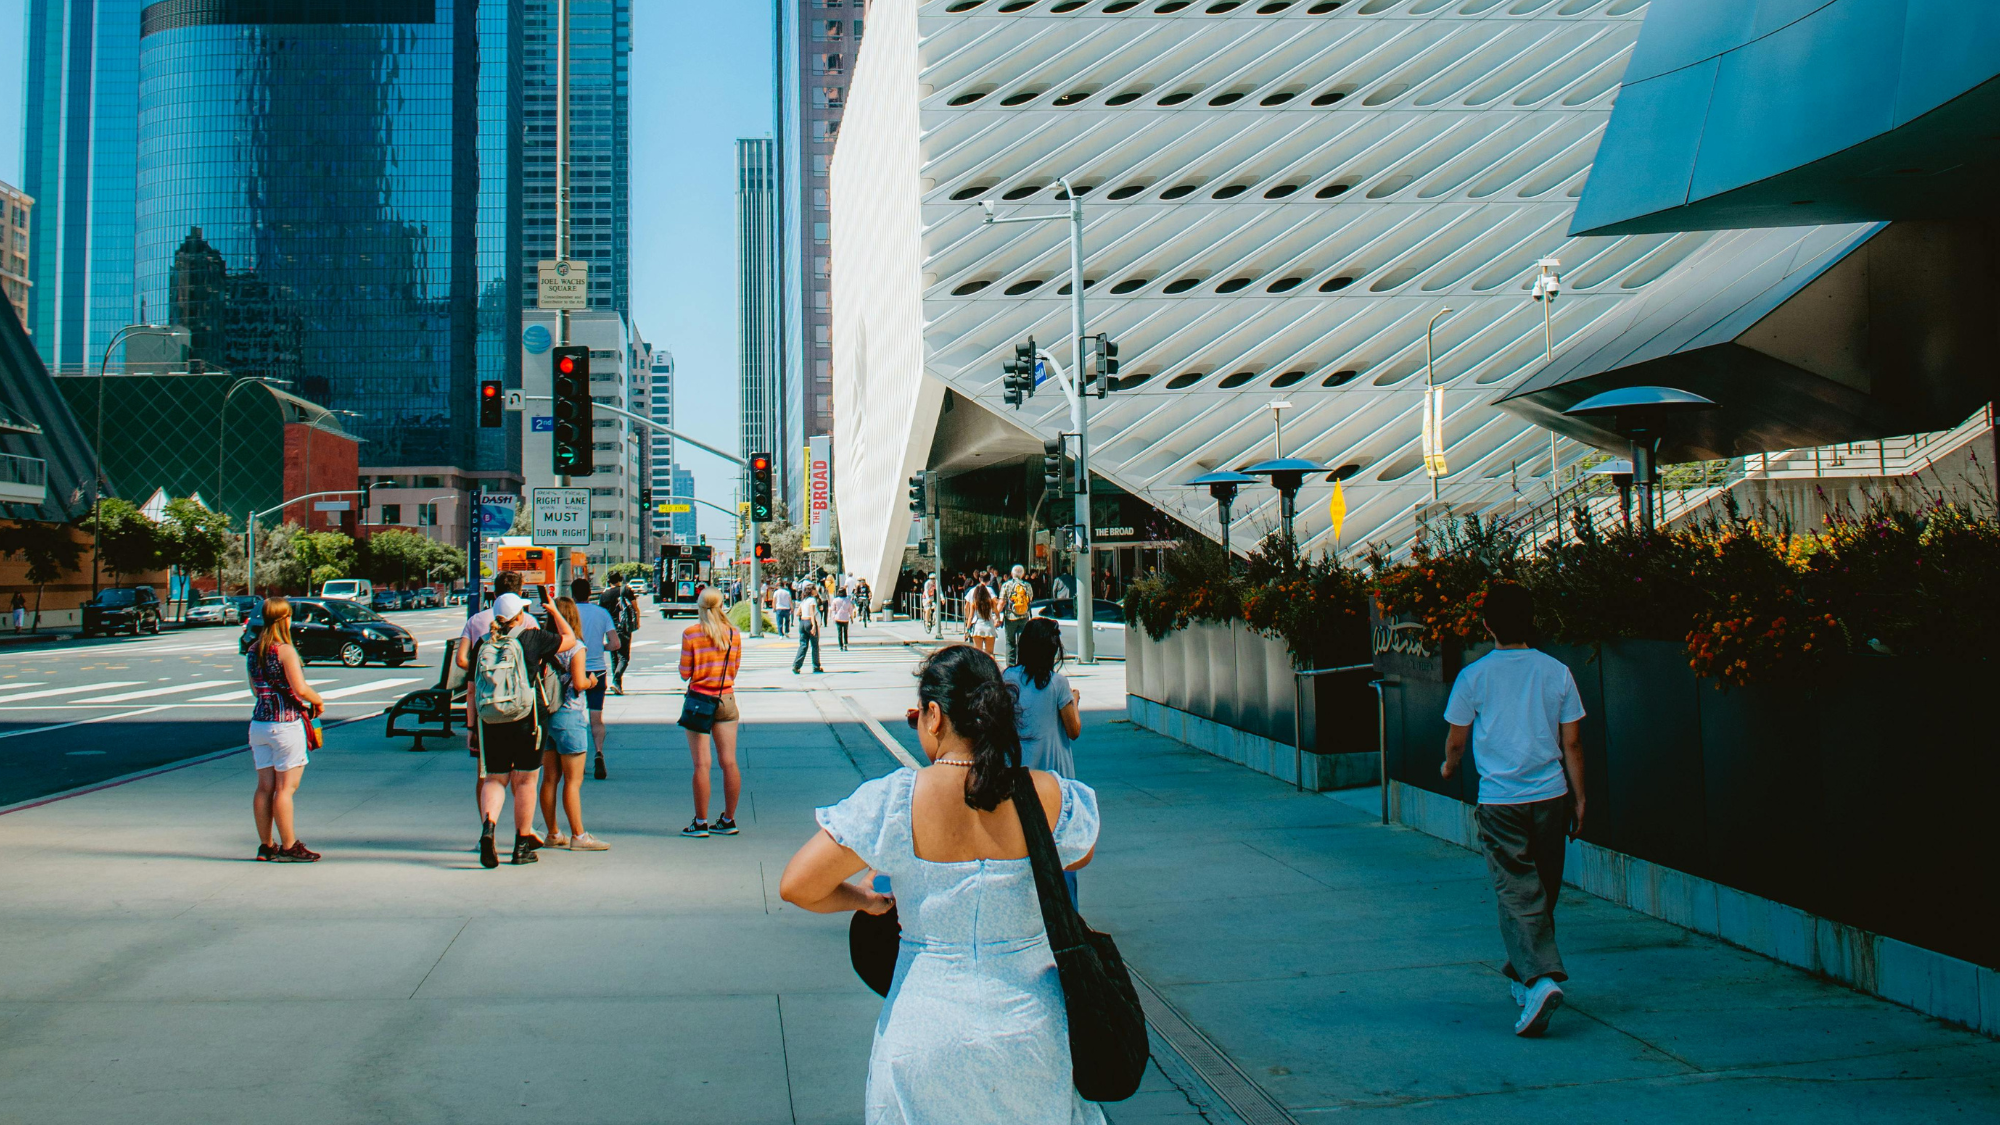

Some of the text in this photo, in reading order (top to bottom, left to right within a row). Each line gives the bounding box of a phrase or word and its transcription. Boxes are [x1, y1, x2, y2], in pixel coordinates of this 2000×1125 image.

[536, 419, 552, 430] 2nd
[813, 460, 828, 509] BROAD
[482, 495, 513, 504] DASH
[536, 497, 587, 505] RIGHT LANE
[544, 512, 579, 522] MUST
[536, 529, 587, 537] TURN RIGHT
[1095, 527, 1134, 537] THE BROAD
